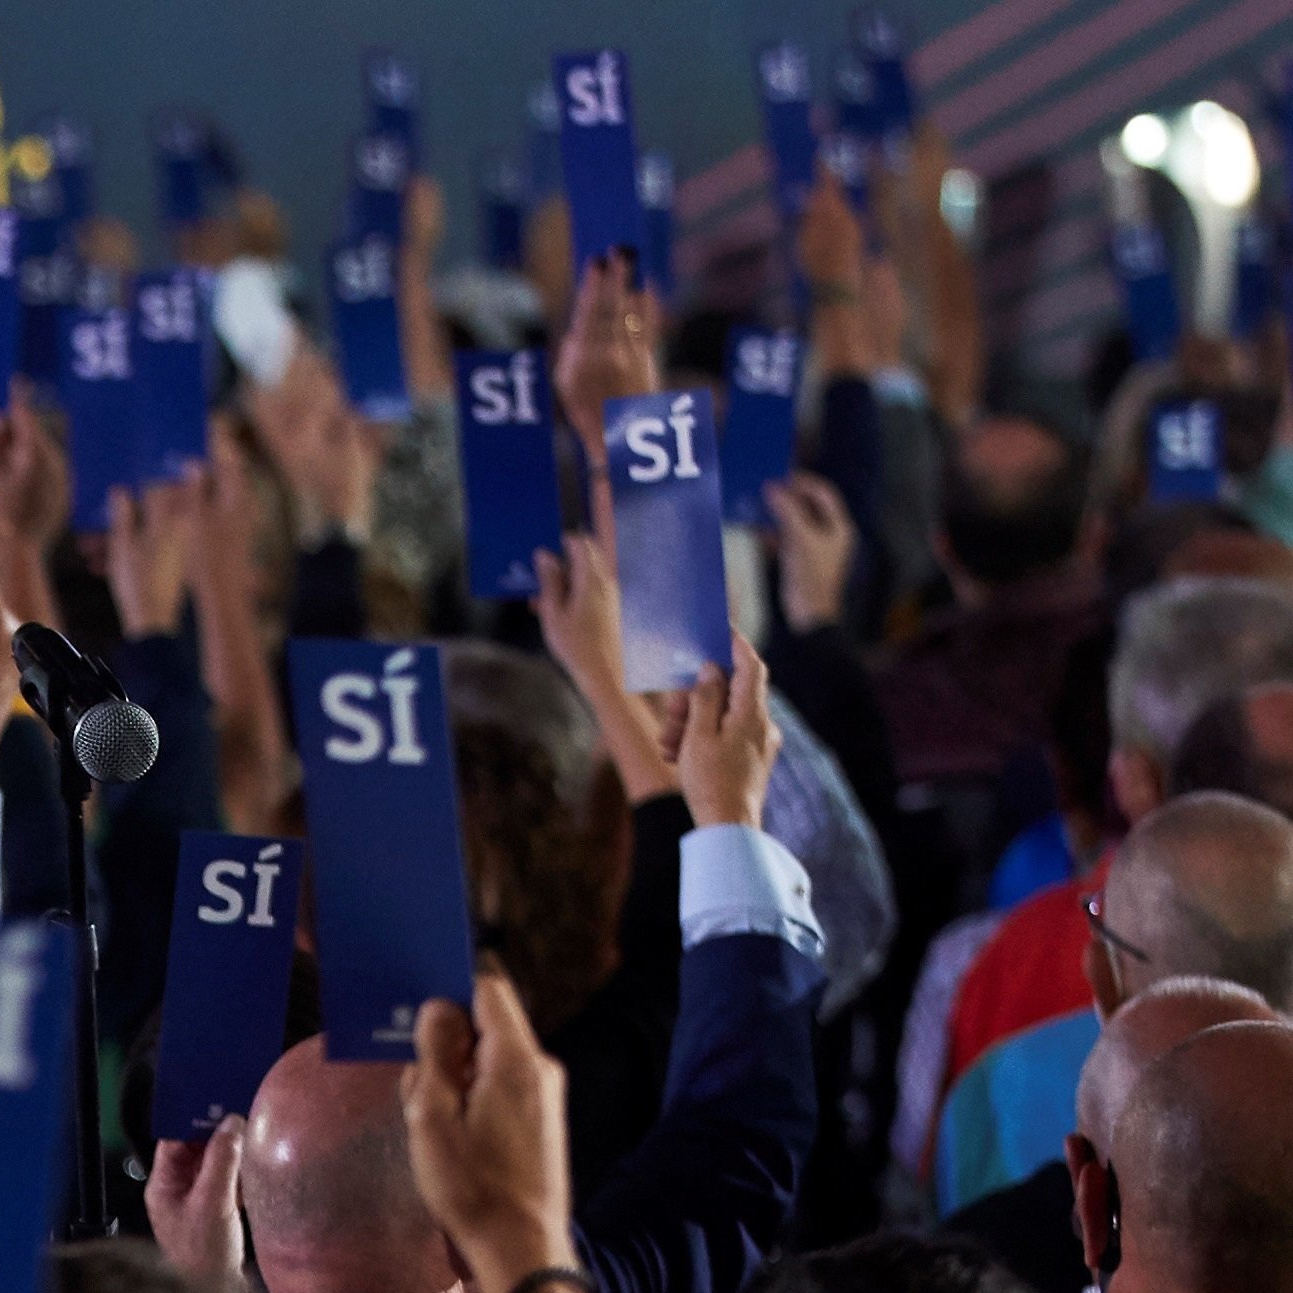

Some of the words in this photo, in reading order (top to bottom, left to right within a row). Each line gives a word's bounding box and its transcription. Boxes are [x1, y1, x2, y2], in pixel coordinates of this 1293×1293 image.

[566, 50, 621, 125] SÍ
[470, 350, 540, 425] SÍ
[623, 394, 701, 482] SÍ
[319, 648, 426, 765] SÍ
[198, 843, 284, 927] SÍ
